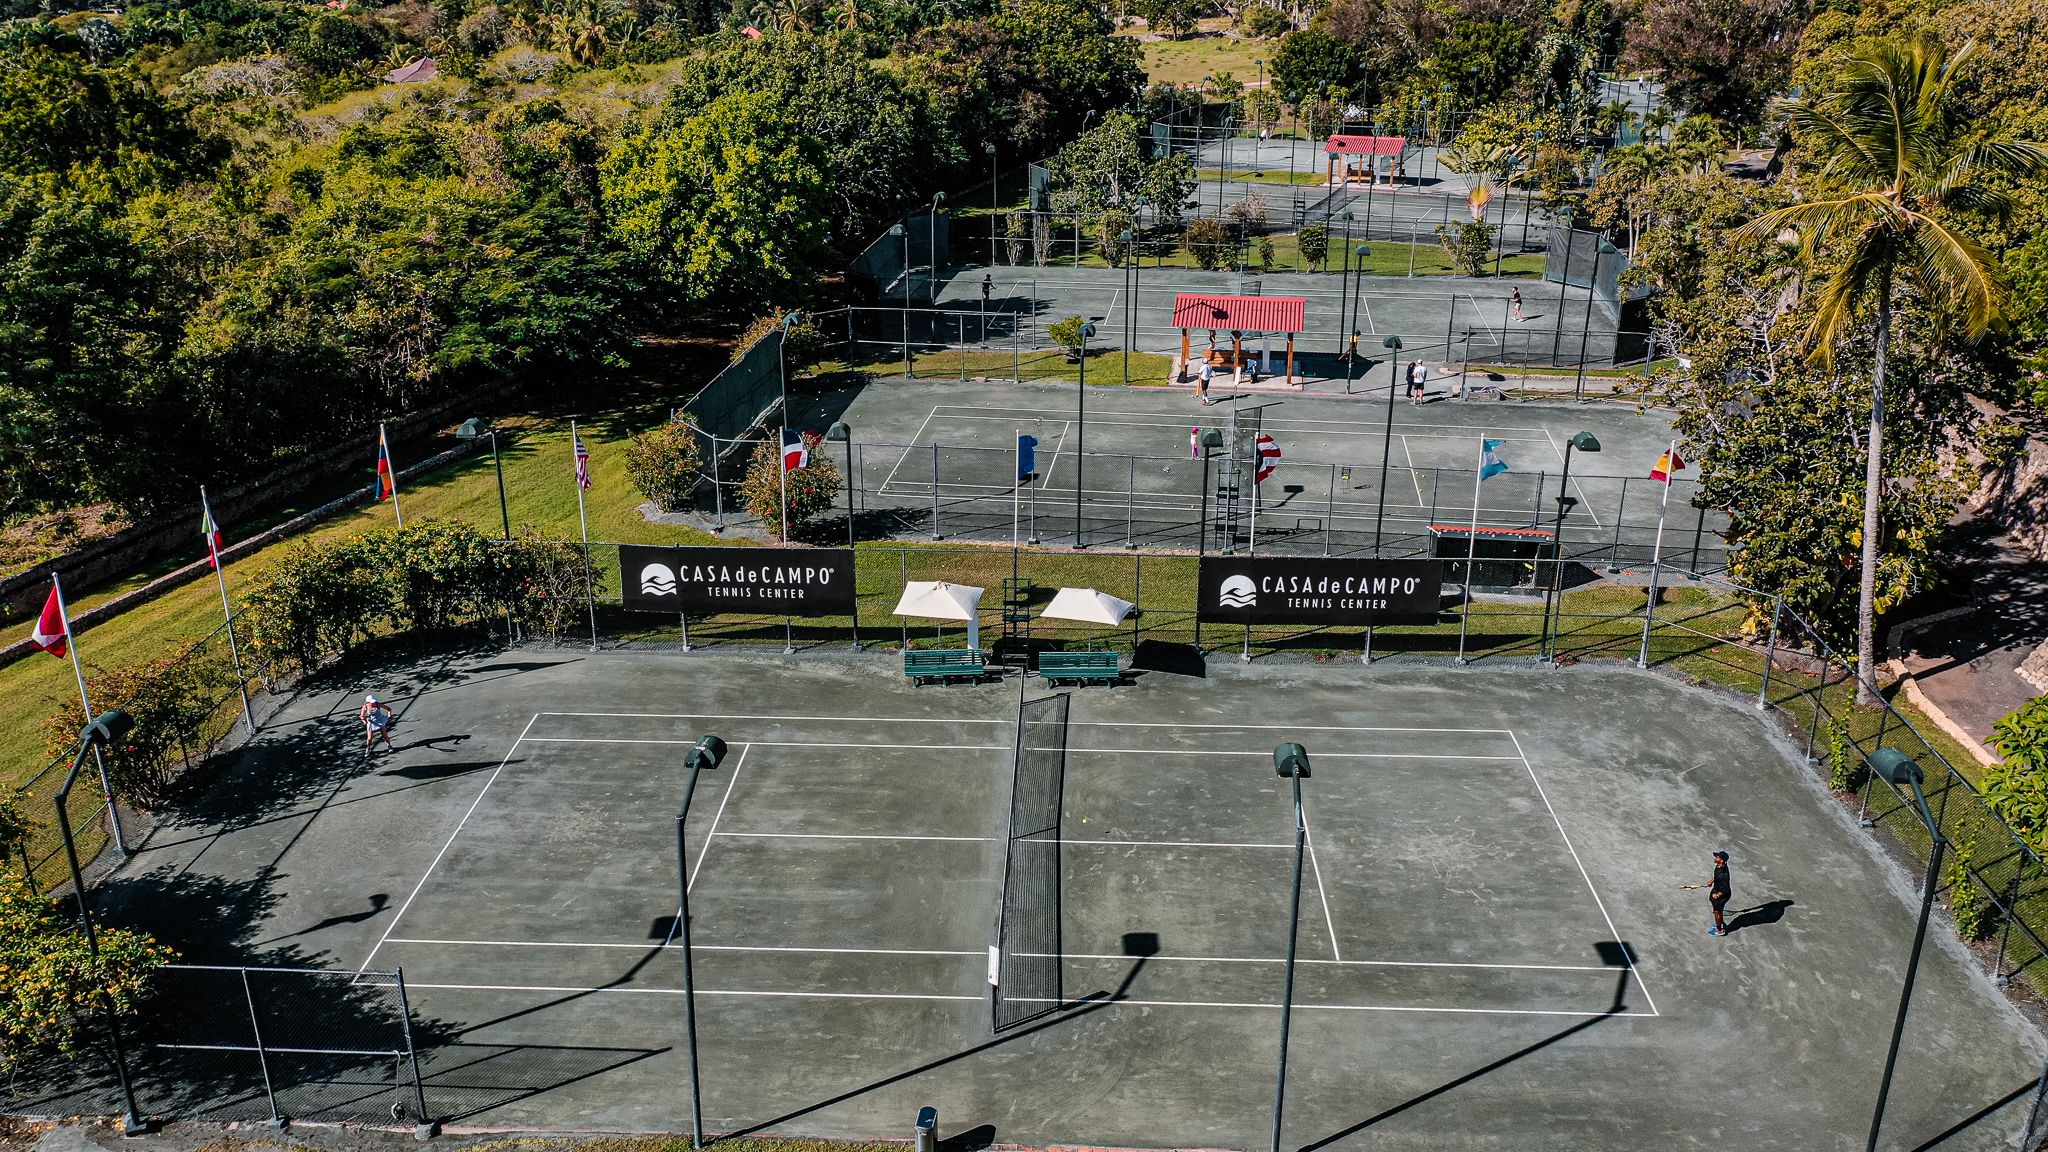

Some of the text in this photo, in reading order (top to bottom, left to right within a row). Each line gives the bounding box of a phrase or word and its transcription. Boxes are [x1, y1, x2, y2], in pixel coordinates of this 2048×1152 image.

[708, 586, 804, 600] TENNIS CENTER
[1287, 598, 1387, 610] TENNIS CENTER
